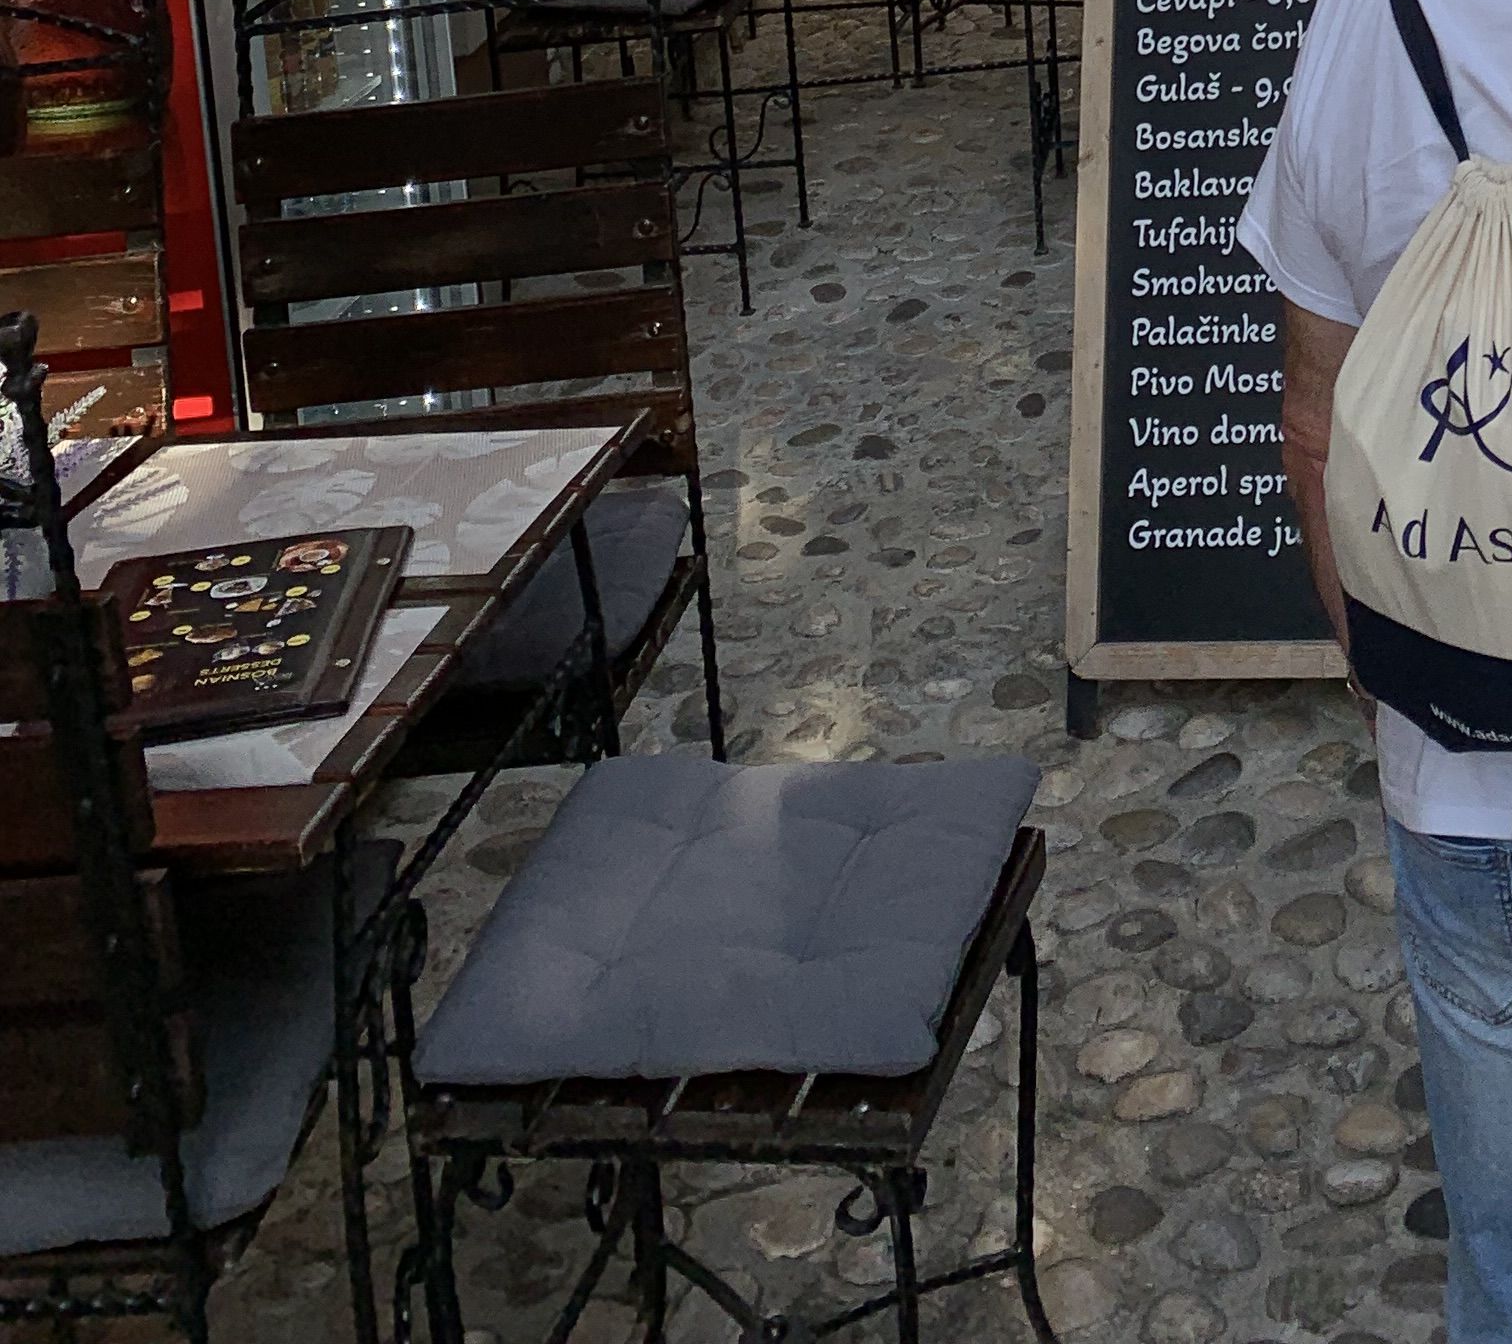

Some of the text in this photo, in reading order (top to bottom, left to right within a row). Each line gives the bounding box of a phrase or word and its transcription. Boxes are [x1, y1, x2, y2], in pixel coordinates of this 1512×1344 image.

[1137, 27, 1241, 64] Begova
[1136, 72, 1222, 103] Gulaš
[1135, 117, 1278, 151] Bosanska
[1135, 168, 1255, 199] Baklava
[1132, 215, 1236, 256] Tufahij
[1131, 313, 1277, 346] Palačinke
[1130, 364, 1286, 396] Pivo Most
[1128, 417, 1199, 447] Vino
[1128, 465, 1287, 508] Aperol spr
[1128, 515, 1303, 557] Granade ju
[1371, 497, 1428, 559] Ad
[193, 668, 278, 687] BOSNIAN
[199, 658, 283, 676] DESSERTS
